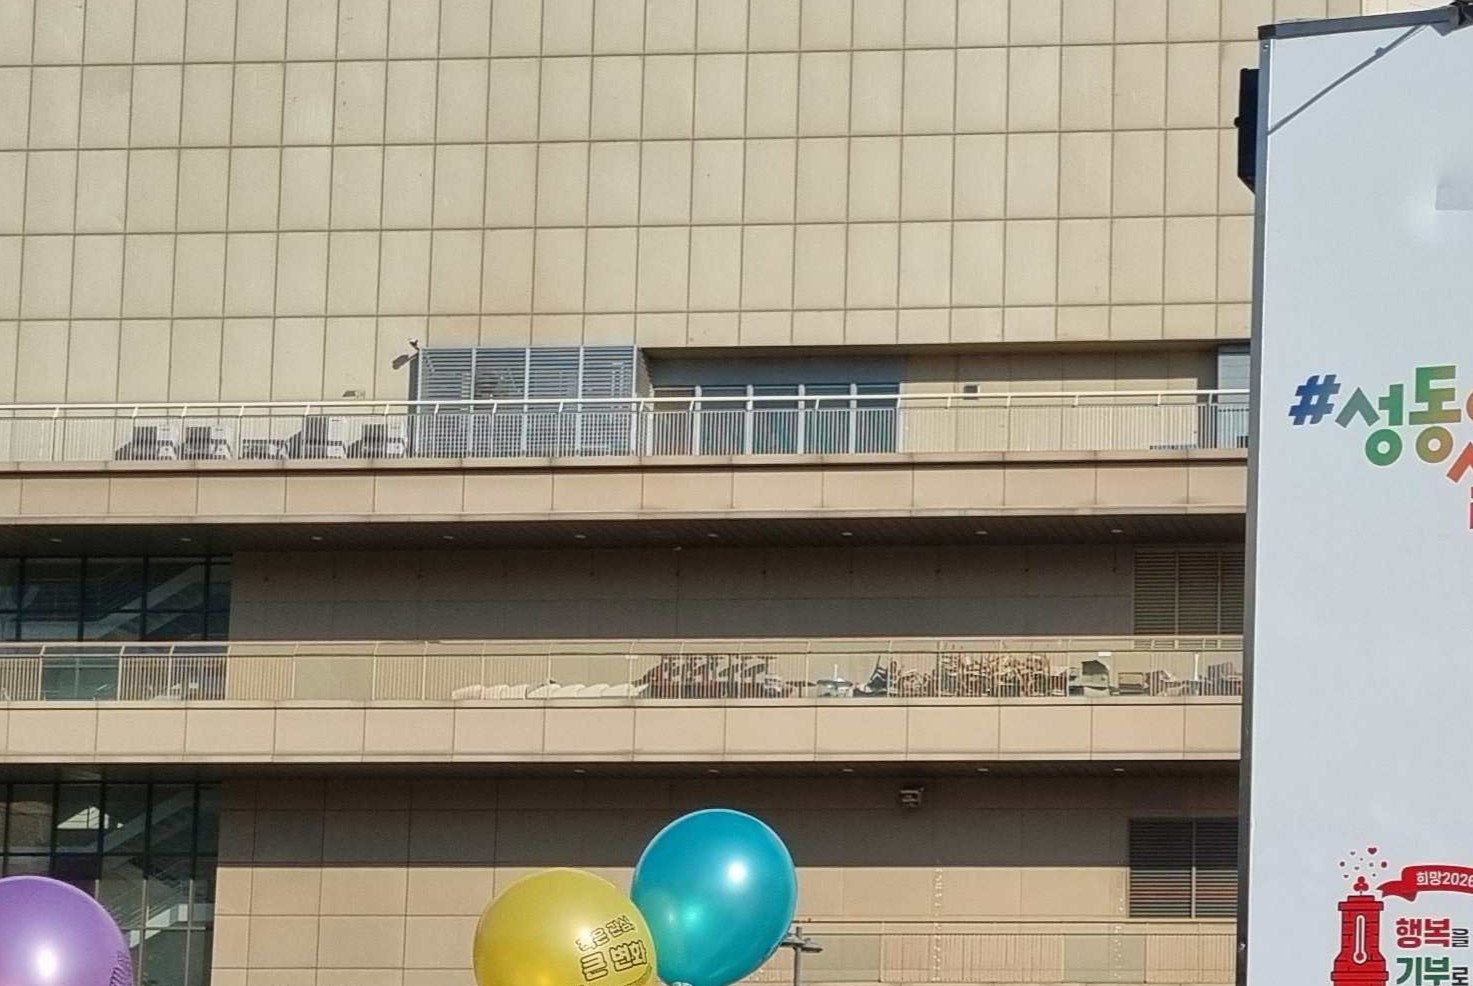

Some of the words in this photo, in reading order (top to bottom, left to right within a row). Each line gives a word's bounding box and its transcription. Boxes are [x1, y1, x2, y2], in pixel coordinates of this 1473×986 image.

[1396, 917, 1469, 949] 행복을
[580, 951, 608, 982] 큰
[609, 940, 648, 973] 변화
[1396, 956, 1469, 986] 기부로
